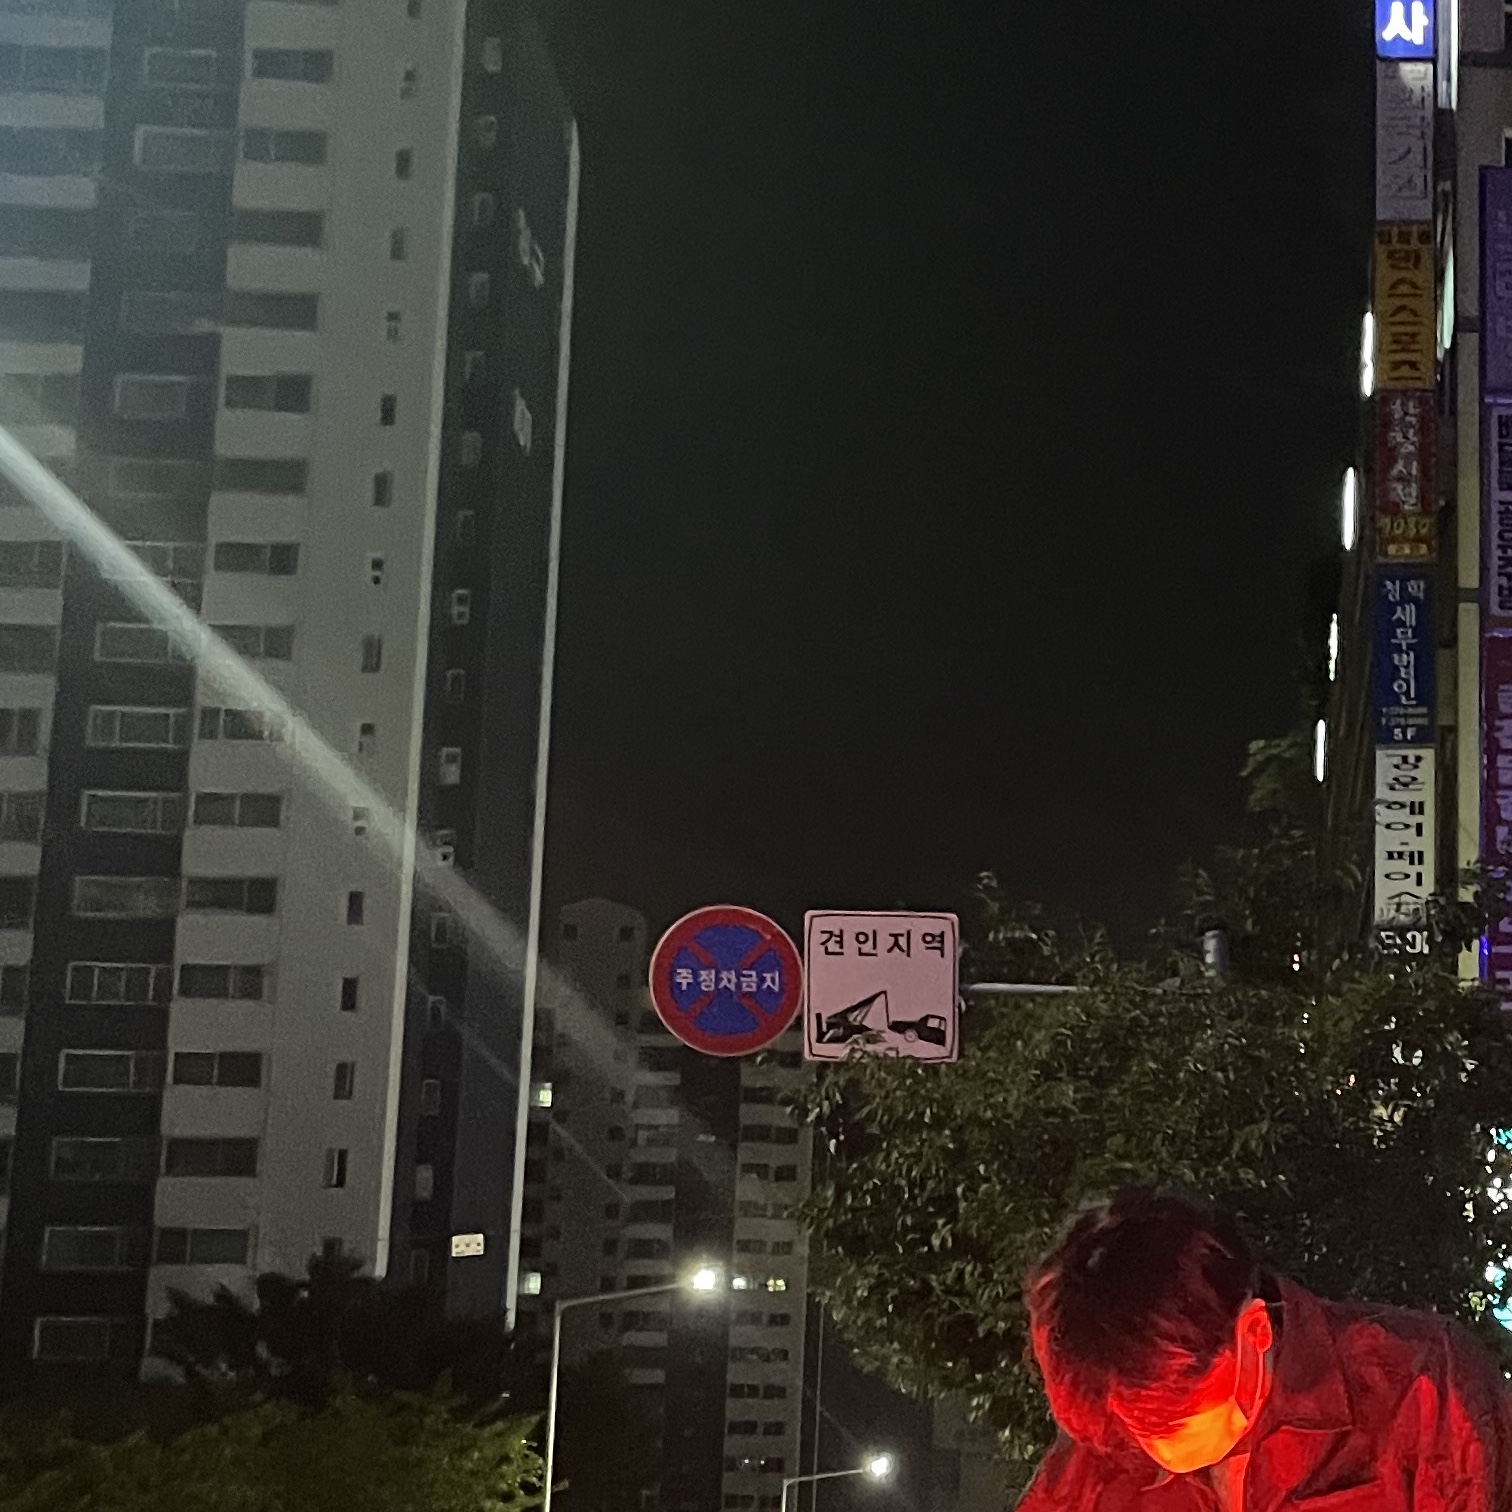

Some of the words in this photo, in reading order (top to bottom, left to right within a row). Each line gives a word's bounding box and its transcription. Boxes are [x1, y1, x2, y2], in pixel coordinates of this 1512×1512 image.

[1390, 603, 1419, 706] 세무법인
[819, 928, 946, 958] 견인지역
[675, 967, 781, 992] 주정차금지
